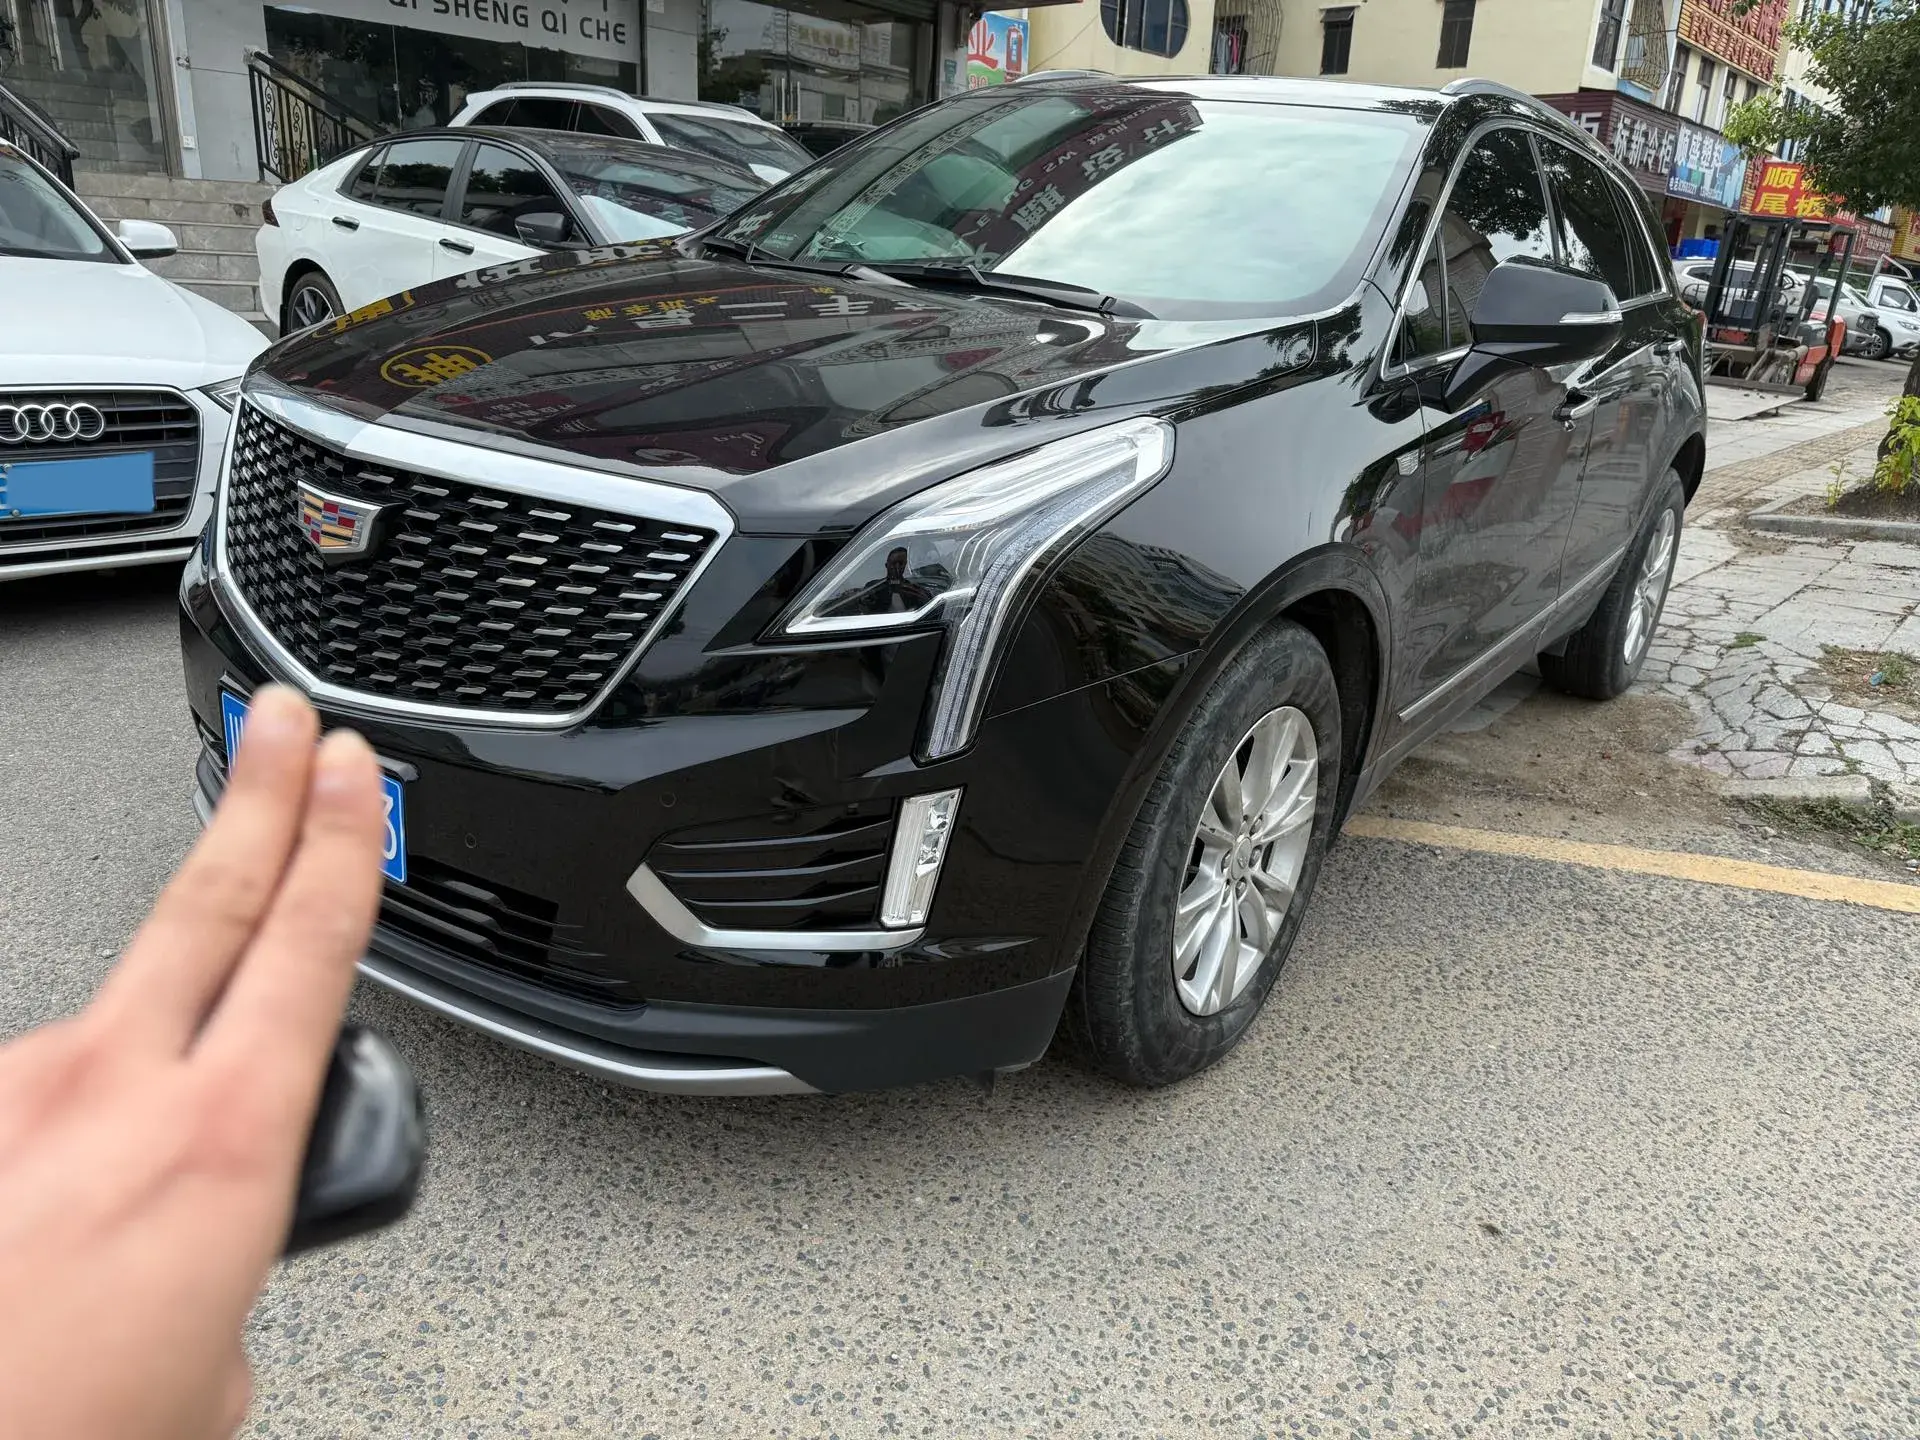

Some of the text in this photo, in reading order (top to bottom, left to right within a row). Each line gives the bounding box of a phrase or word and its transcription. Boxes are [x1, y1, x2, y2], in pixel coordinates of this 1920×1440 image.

[433, 0, 529, 28] SHENG
[541, 10, 568, 34] QI
[579, 17, 627, 45] CHE
[1755, 192, 1826, 218] 尾板
